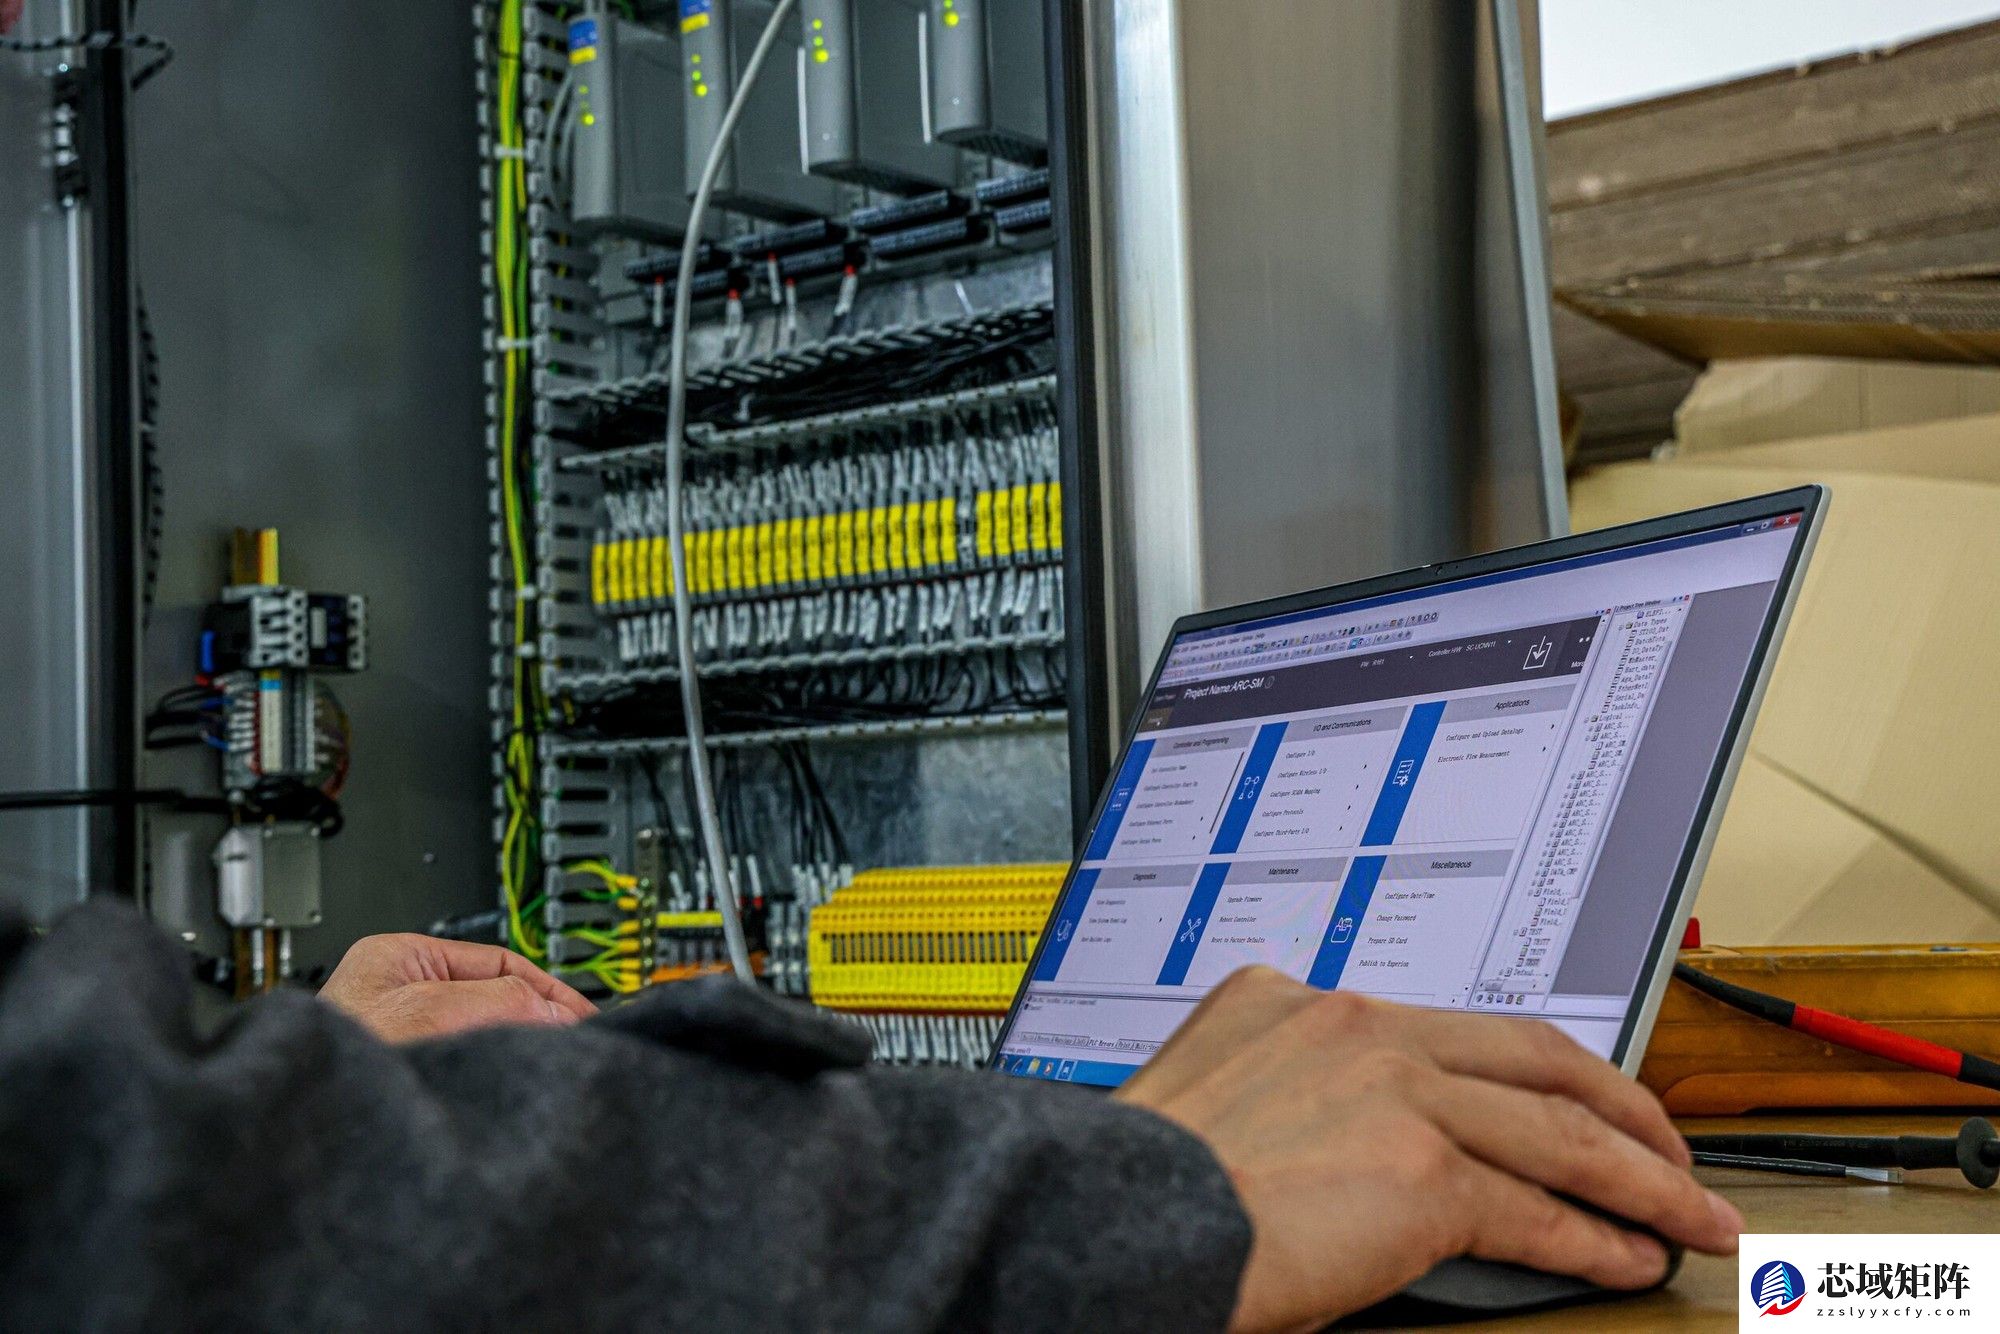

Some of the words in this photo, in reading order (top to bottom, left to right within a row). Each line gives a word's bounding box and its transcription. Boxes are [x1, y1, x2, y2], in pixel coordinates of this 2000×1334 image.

[1184, 687, 1209, 700] Project
[1494, 700, 1530, 710] Applications
[1321, 723, 1331, 731] and
[1332, 719, 1372, 730] Communications
[1446, 734, 1470, 742] Configure
[1438, 755, 1464, 763] Electronic
[1479, 750, 1511, 759] Measurement
[1431, 861, 1472, 869] Miscellaneous
[1387, 960, 1409, 968] Experion
